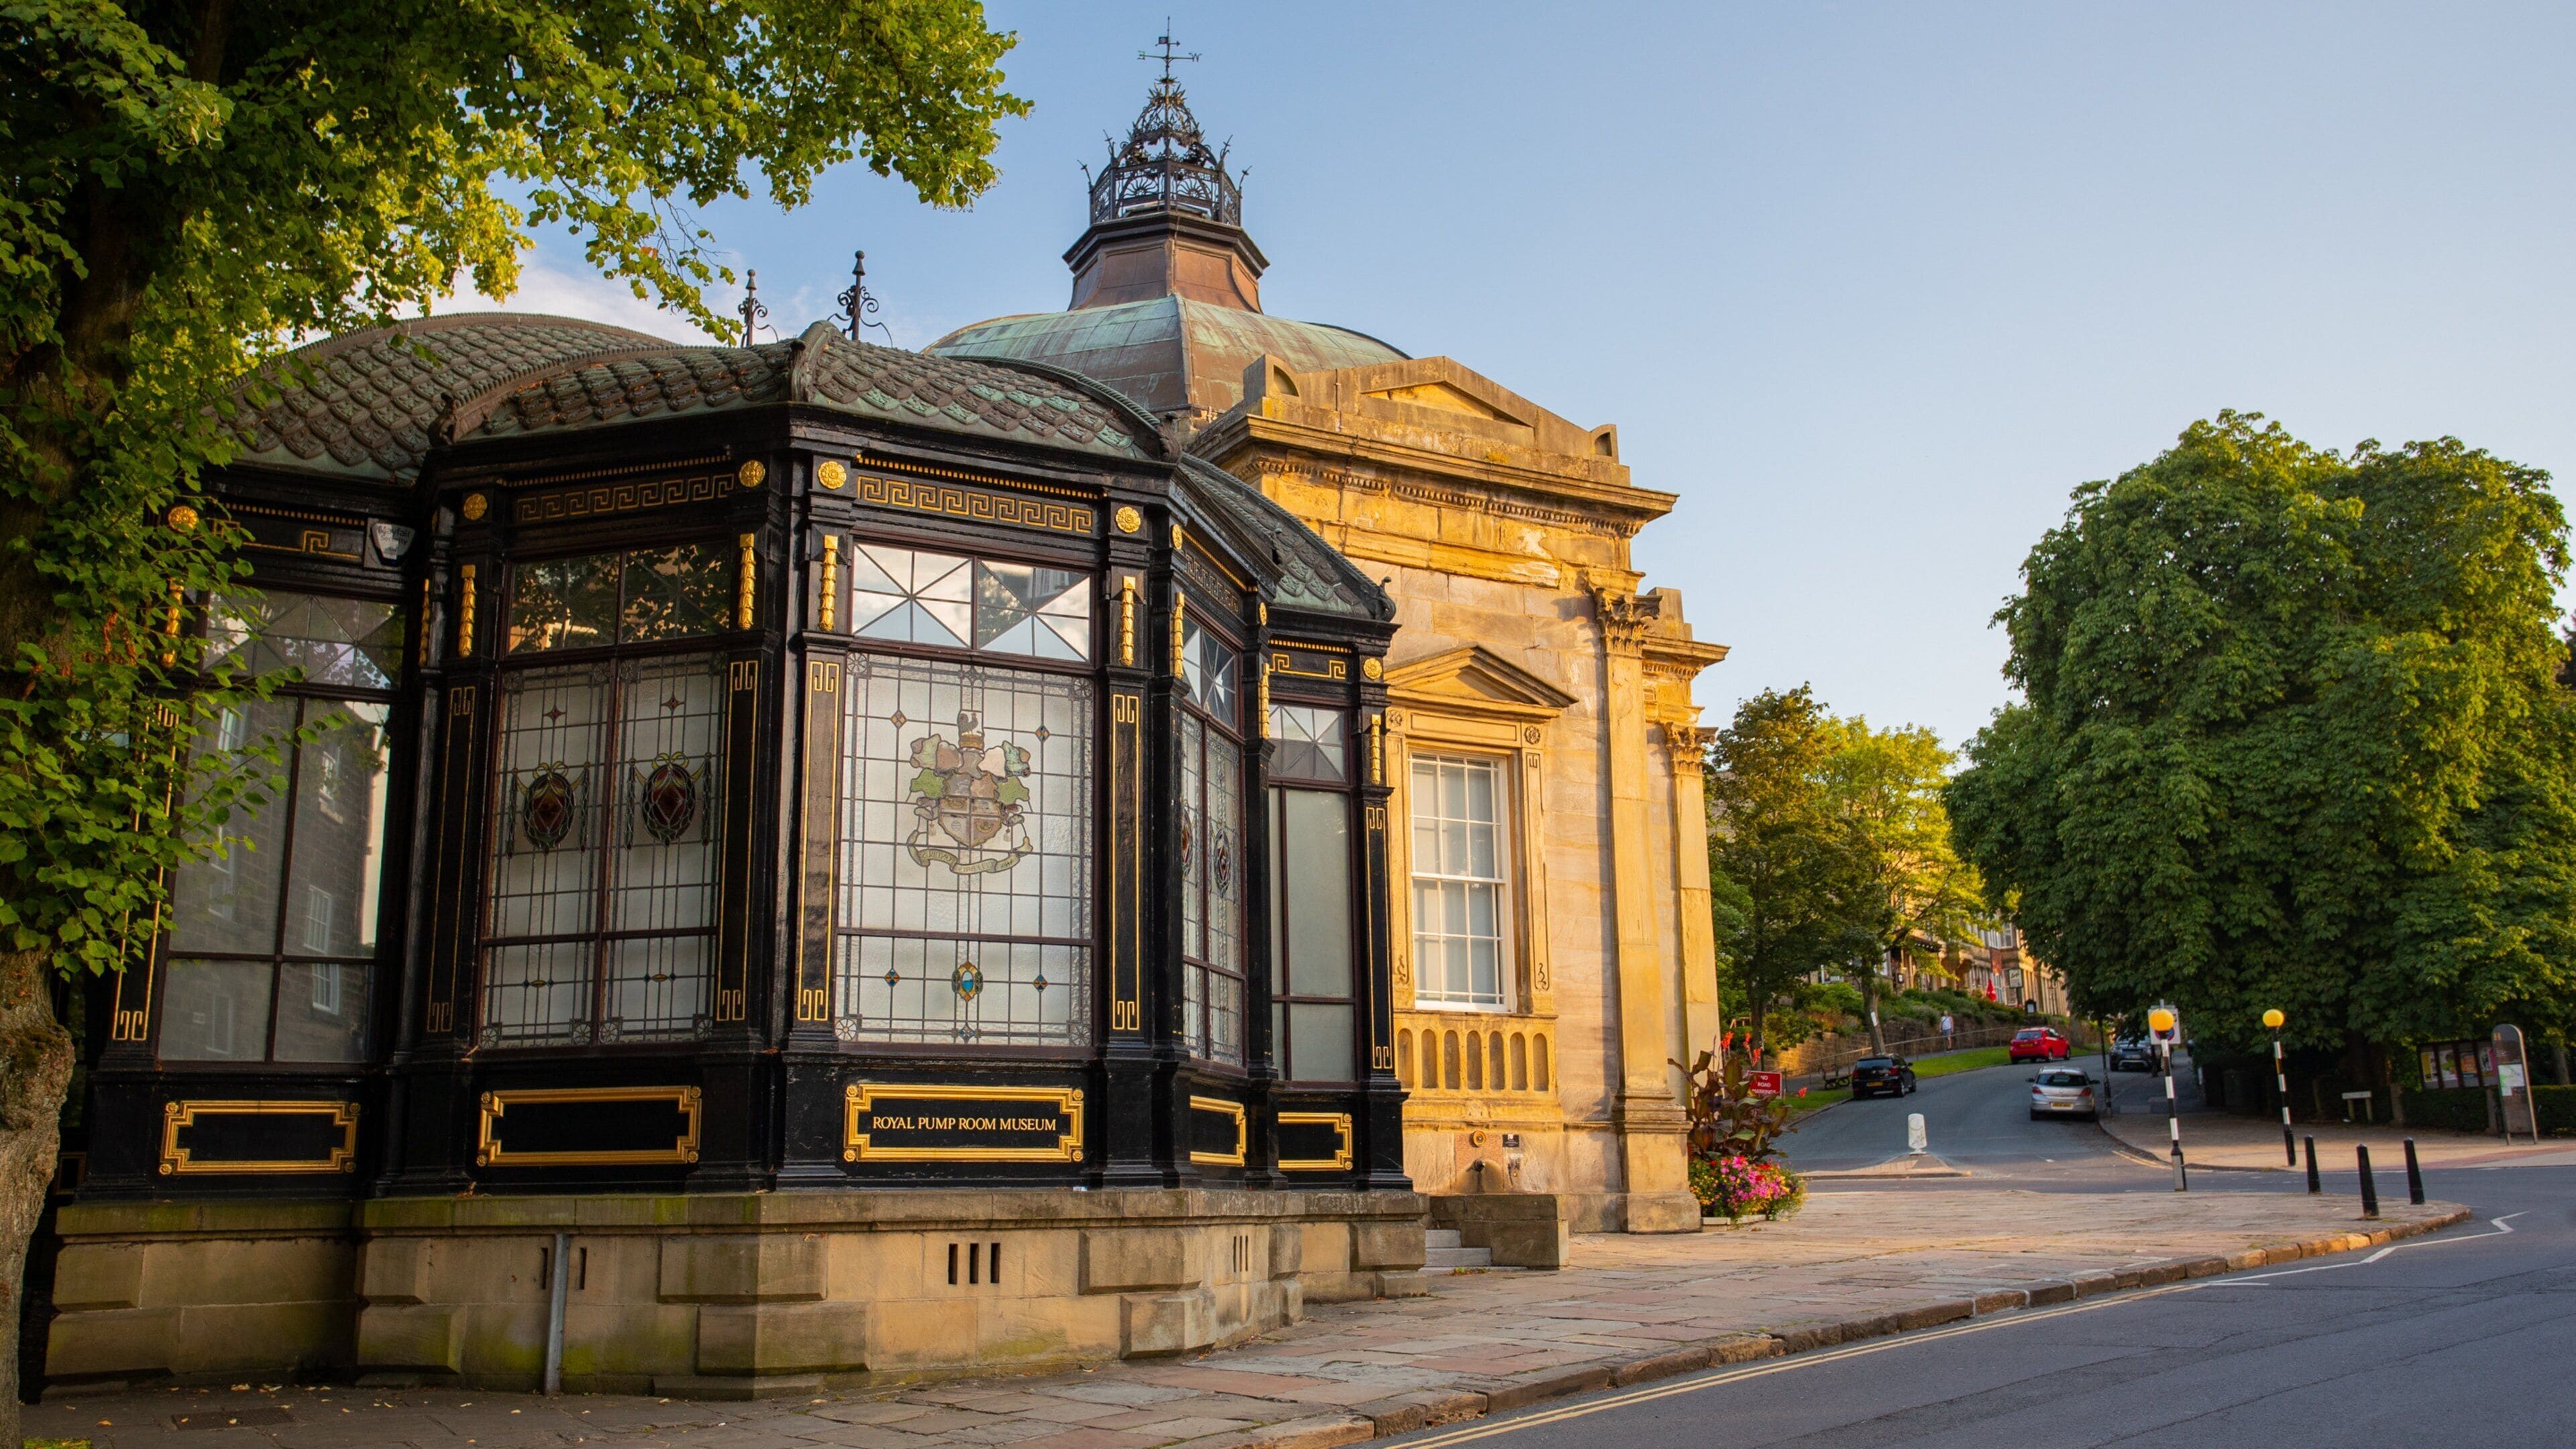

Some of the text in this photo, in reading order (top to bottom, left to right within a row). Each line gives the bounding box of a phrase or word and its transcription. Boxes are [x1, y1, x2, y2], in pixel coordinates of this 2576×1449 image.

[872, 1116, 1057, 1131] ROYAL PUMP ROOM MUSEUM
